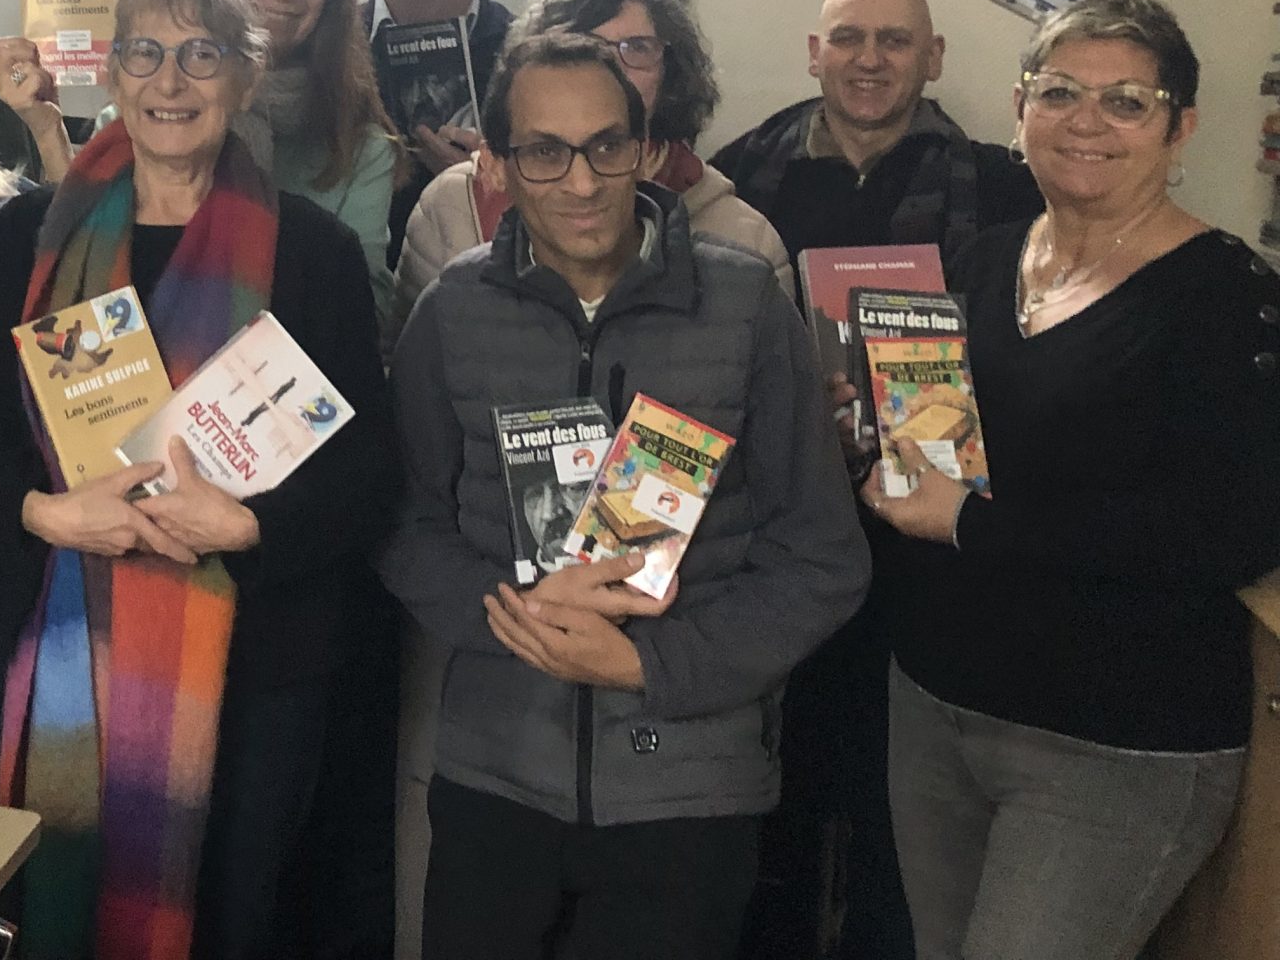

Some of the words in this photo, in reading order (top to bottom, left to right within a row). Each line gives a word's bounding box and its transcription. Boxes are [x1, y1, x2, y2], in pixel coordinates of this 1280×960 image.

[858, 307, 877, 324] Le
[877, 310, 905, 327] vent
[906, 311, 930, 328] des
[931, 312, 959, 331] fous
[63, 375, 104, 400] KARINE
[105, 357, 151, 385] SULPICE
[64, 406, 86, 420] Les
[85, 394, 115, 411] bons
[87, 396, 149, 426] sentiments
[187, 400, 257, 482] BUTTERLIN
[208, 400, 260, 462] Jean-Marc
[502, 431, 522, 450] Le
[522, 429, 554, 448] vent
[553, 426, 578, 444] des
[578, 422, 607, 440] fous
[633, 423, 661, 444] POUR
[662, 437, 690, 455] TOUT
[506, 450, 536, 466] Vincent
[644, 442, 658, 456] DE
[660, 448, 692, 472] BREST
